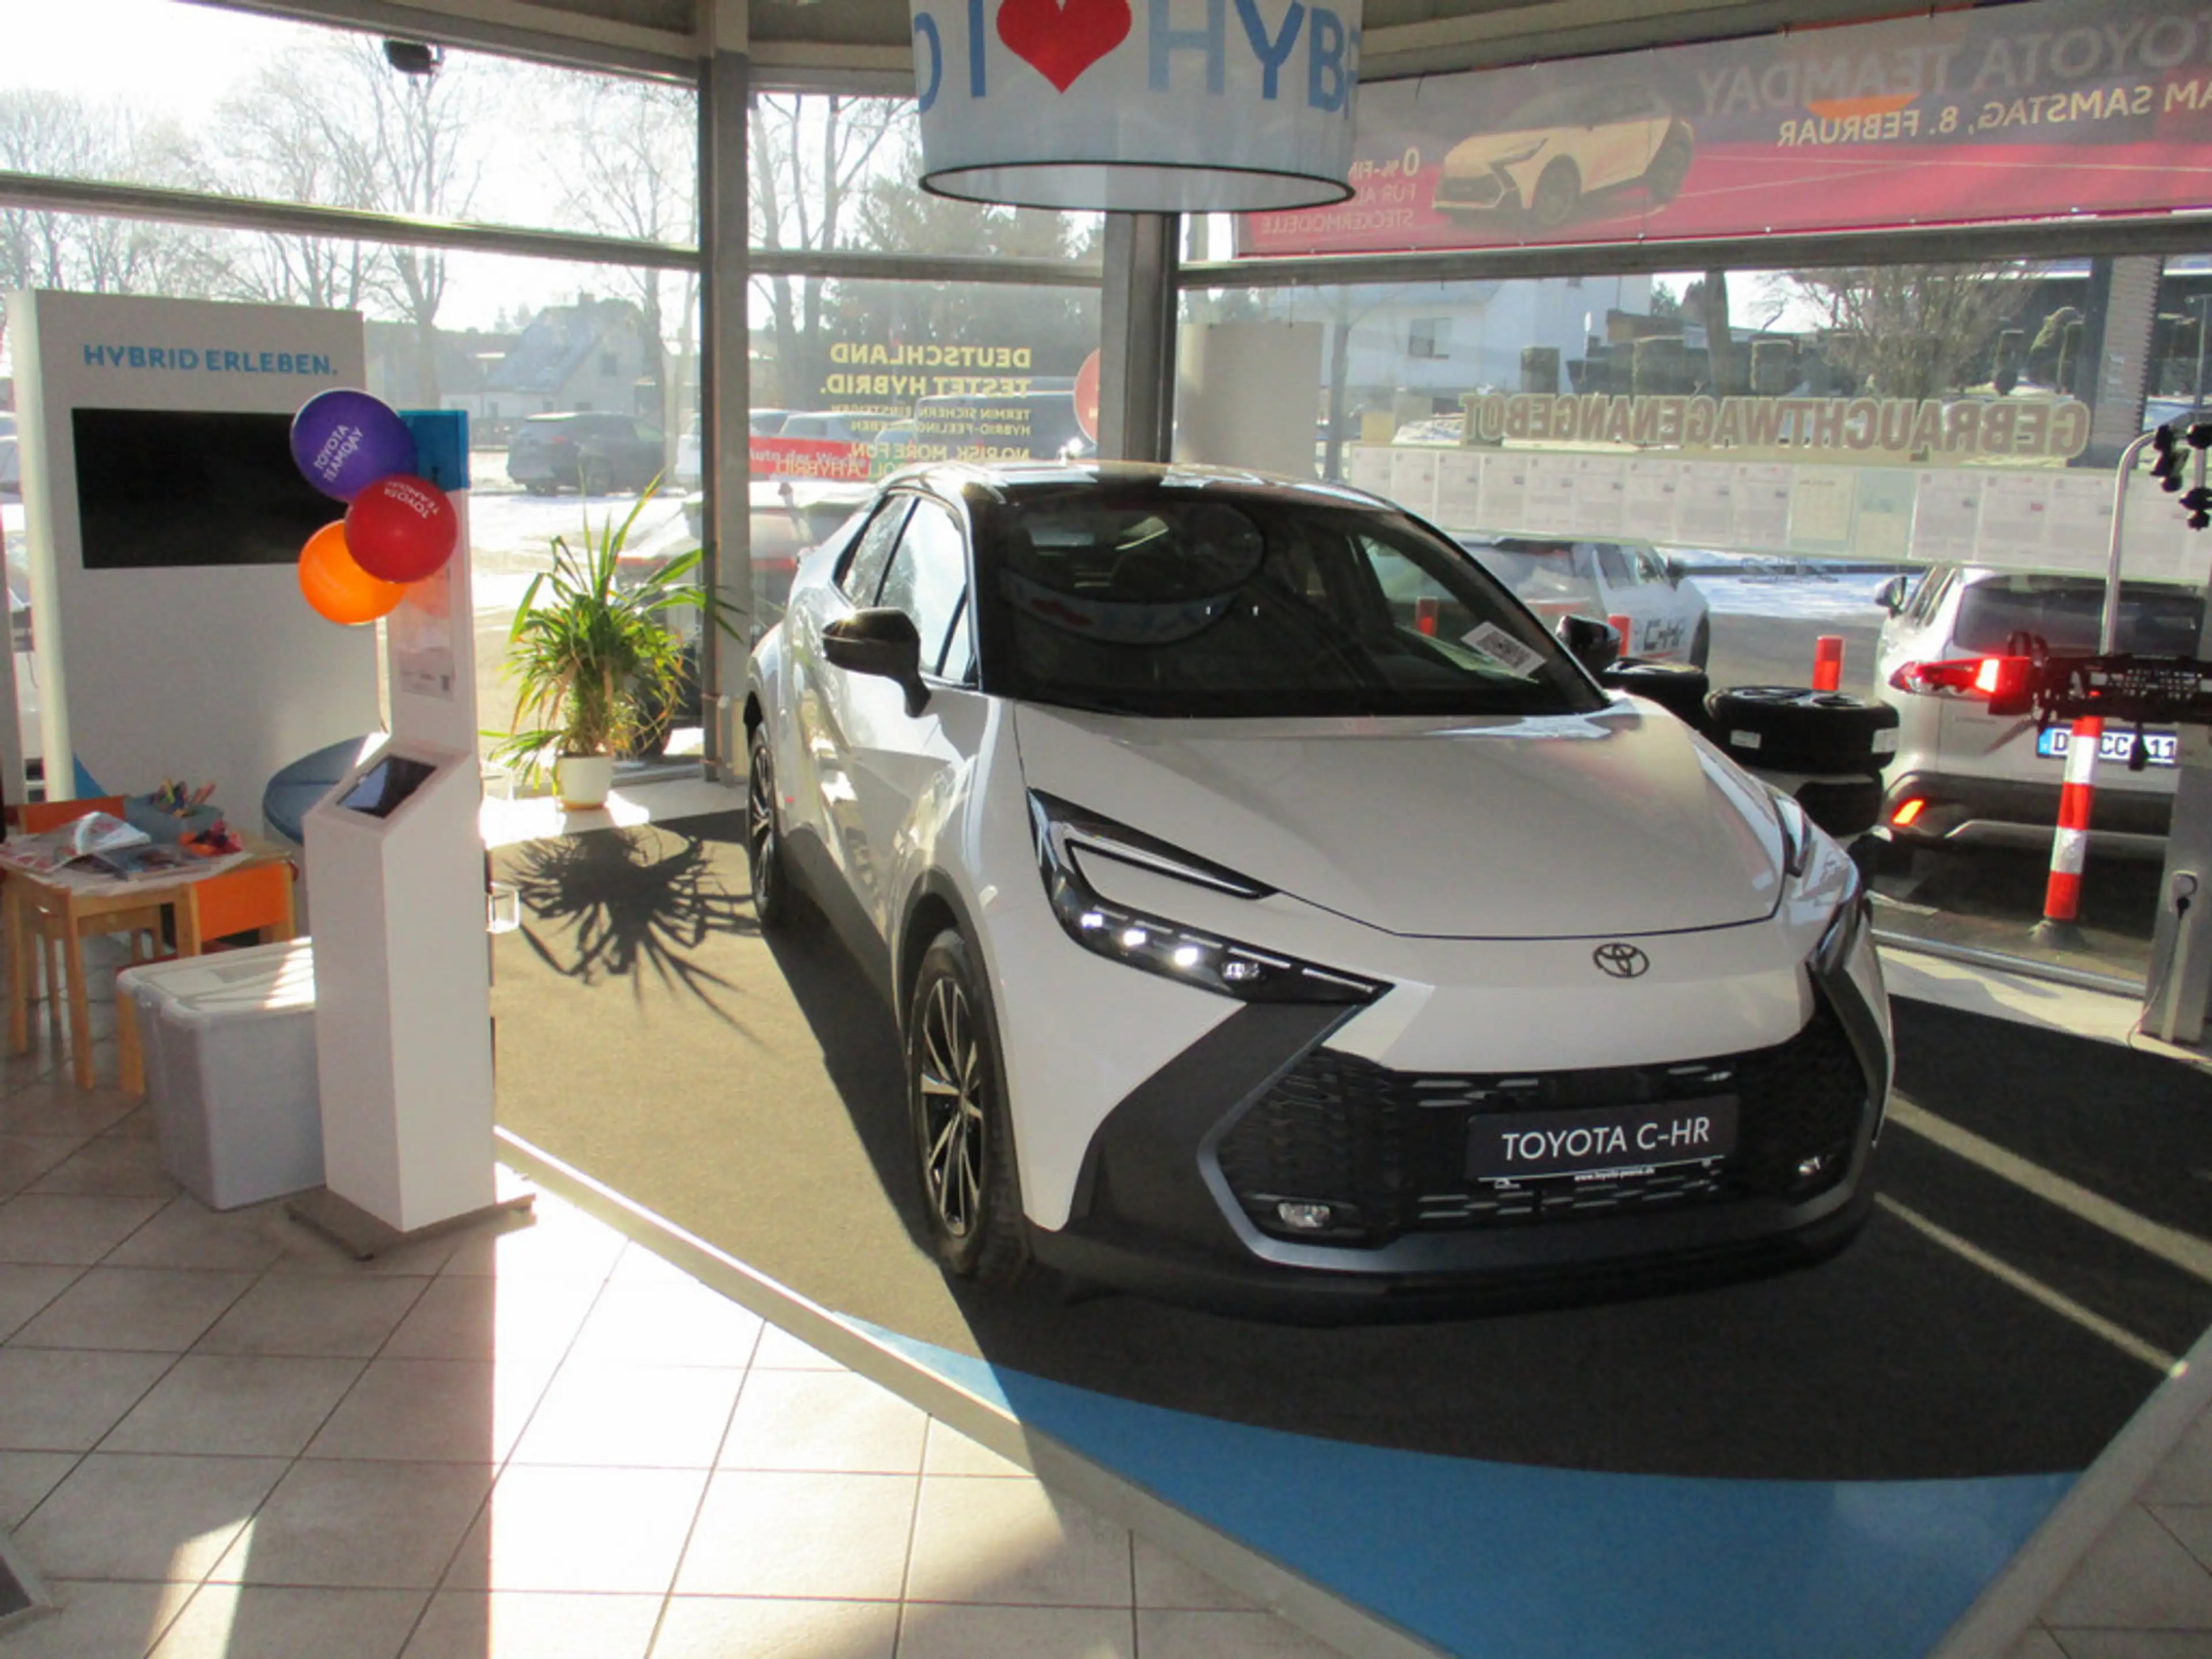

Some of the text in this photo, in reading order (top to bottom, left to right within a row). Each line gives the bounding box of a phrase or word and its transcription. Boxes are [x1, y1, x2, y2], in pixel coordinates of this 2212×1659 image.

[83, 344, 339, 376] HYBRID ERLEBEN.
[314, 424, 350, 470] TOYOTA
[1501, 1116, 1711, 1161] TOYOTA C-HR
